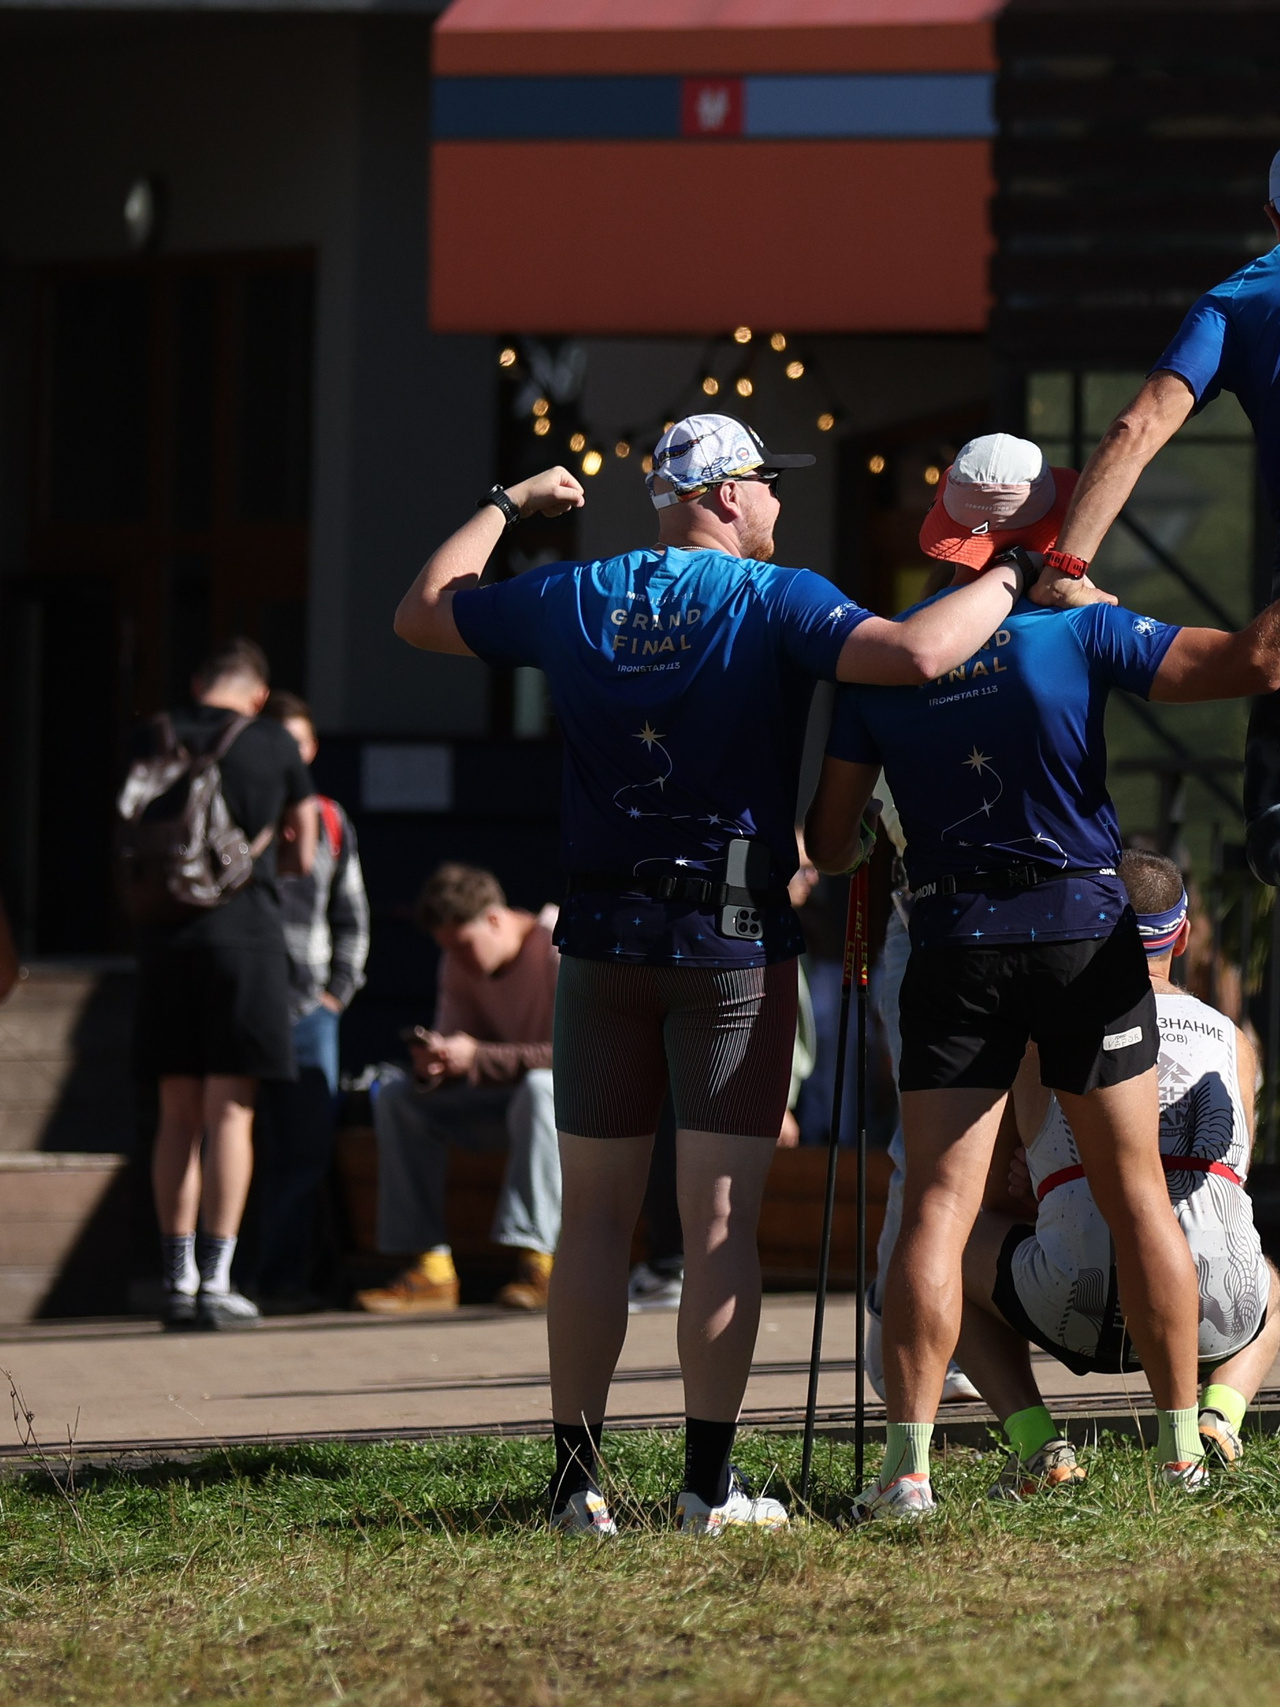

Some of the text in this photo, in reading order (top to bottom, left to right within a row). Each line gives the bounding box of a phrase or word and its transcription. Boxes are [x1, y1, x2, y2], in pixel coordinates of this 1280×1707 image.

[611, 608, 701, 631] GRAND
[612, 634, 692, 656] FINAL
[617, 664, 666, 673] IRONSTAR
[920, 657, 1007, 689] INAL
[929, 685, 998, 707] IRONSTAR 113
[1158, 1017, 1225, 1043] ЗНАНИЕ
[1159, 1033, 1188, 1045] КОВ)
